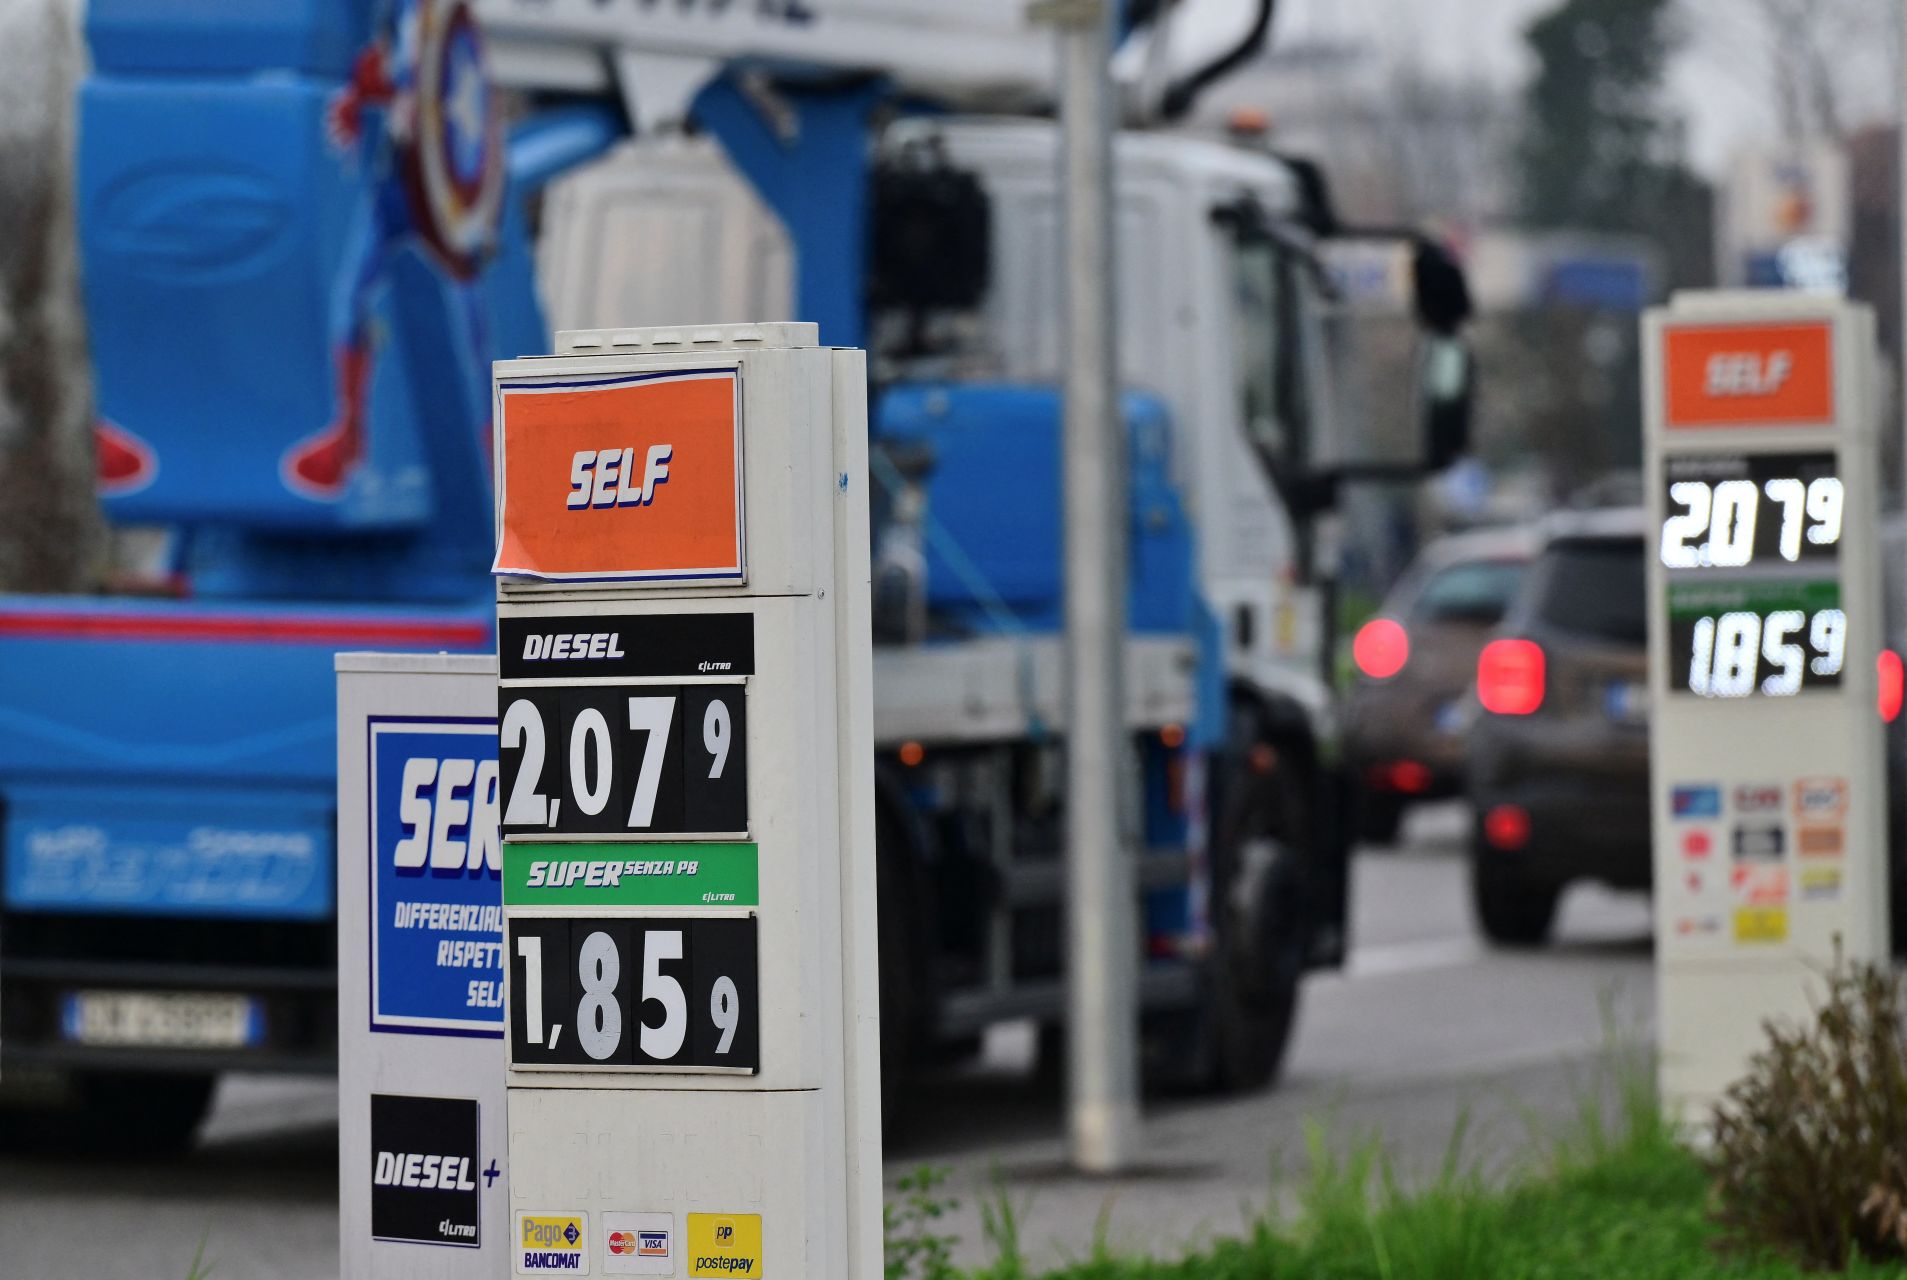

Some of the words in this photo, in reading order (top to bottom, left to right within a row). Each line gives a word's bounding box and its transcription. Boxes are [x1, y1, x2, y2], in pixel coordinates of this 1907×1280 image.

[1704, 349, 1793, 397] SELF
[566, 444, 673, 511] SELF
[522, 633, 625, 661] DIESEL
[527, 861, 625, 888] SUPER
[623, 861, 674, 875] SENZA
[676, 861, 698, 875] PB
[374, 1151, 475, 1192] DIESEL
[523, 1219, 562, 1247] Pago
[609, 1239, 636, 1248] MasterCard
[644, 1239, 662, 1249] VISA
[716, 1226, 733, 1239] pp
[524, 1252, 581, 1269] BANCOMAT
[695, 1255, 754, 1273] postepay
